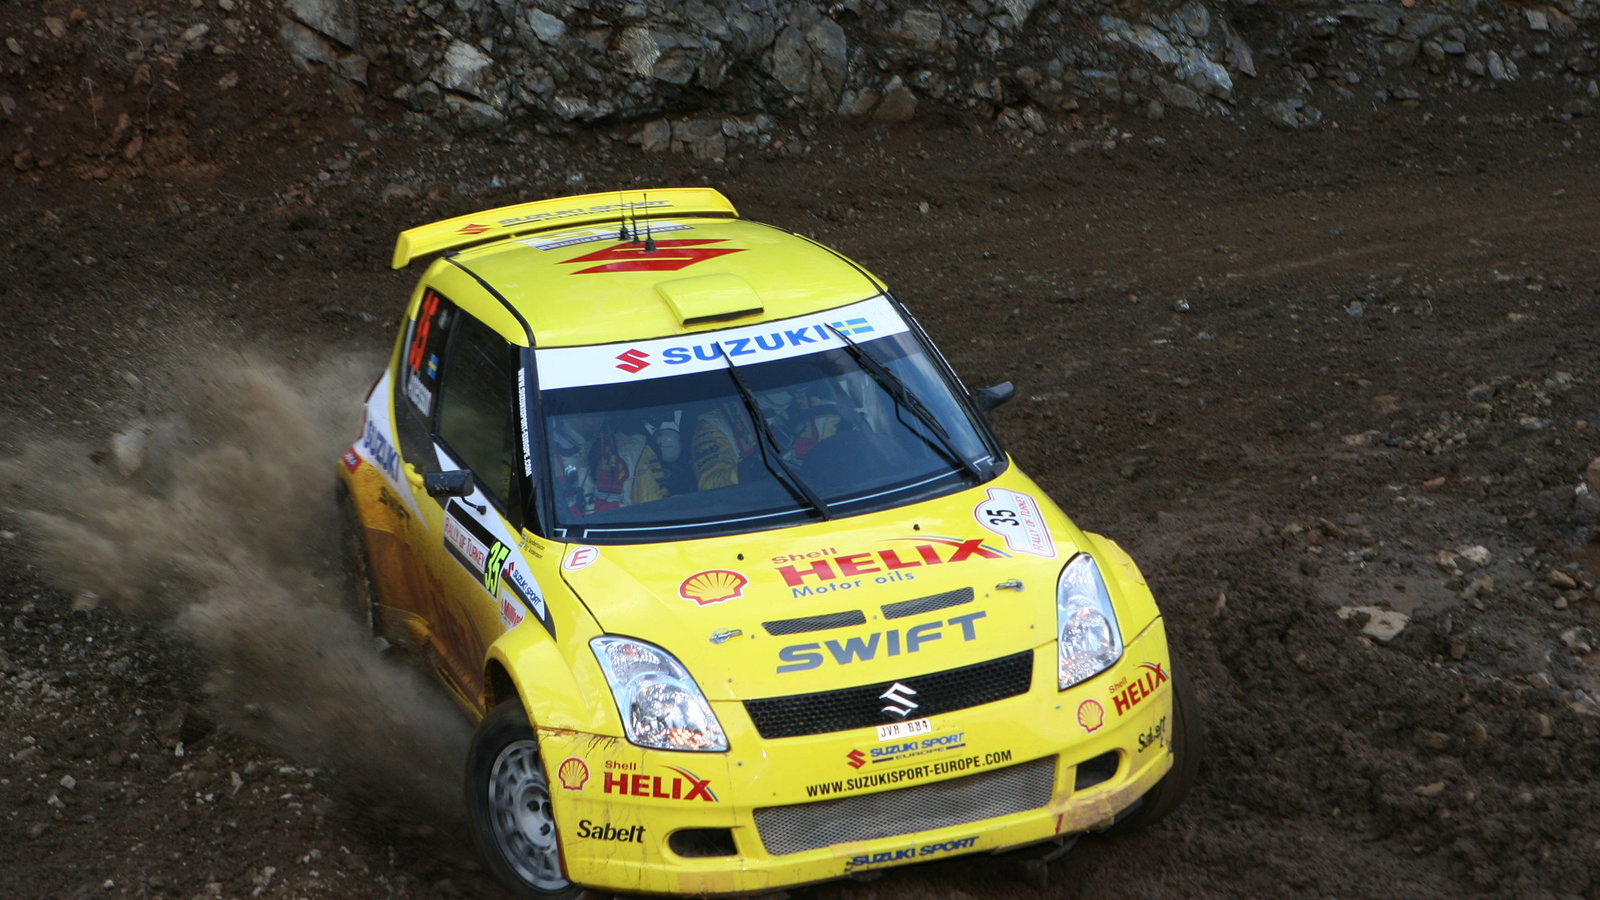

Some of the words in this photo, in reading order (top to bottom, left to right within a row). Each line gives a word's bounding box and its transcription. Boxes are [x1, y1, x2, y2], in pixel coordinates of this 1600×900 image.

[662, 324, 831, 366] SUZUKI
[985, 509, 1020, 527] 35
[444, 516, 460, 541] RALLY
[458, 534, 467, 549] OF
[466, 537, 486, 567] TURKEY
[1029, 529, 1046, 552] RALLY
[484, 541, 510, 595] 35
[570, 549, 592, 568] E
[771, 547, 837, 565] Shell
[774, 538, 1002, 587] HELIX
[513, 569, 529, 590] SUZUKI
[525, 587, 542, 606] SPORT
[791, 579, 862, 599] Motor
[875, 570, 915, 585] oils
[776, 611, 987, 674] SWIFT
[1112, 663, 1167, 716] HELIX
[870, 741, 918, 757] SUZUKI
[921, 732, 964, 749] SPORT
[605, 760, 637, 771] Shell
[806, 750, 1012, 797] WWW.SUZUKISPORT-EUROPE.COM
[603, 772, 715, 802] HELIX
[577, 819, 646, 844] Sabelt
[852, 847, 915, 867] SUZUKI
[919, 836, 979, 857] SPORT
